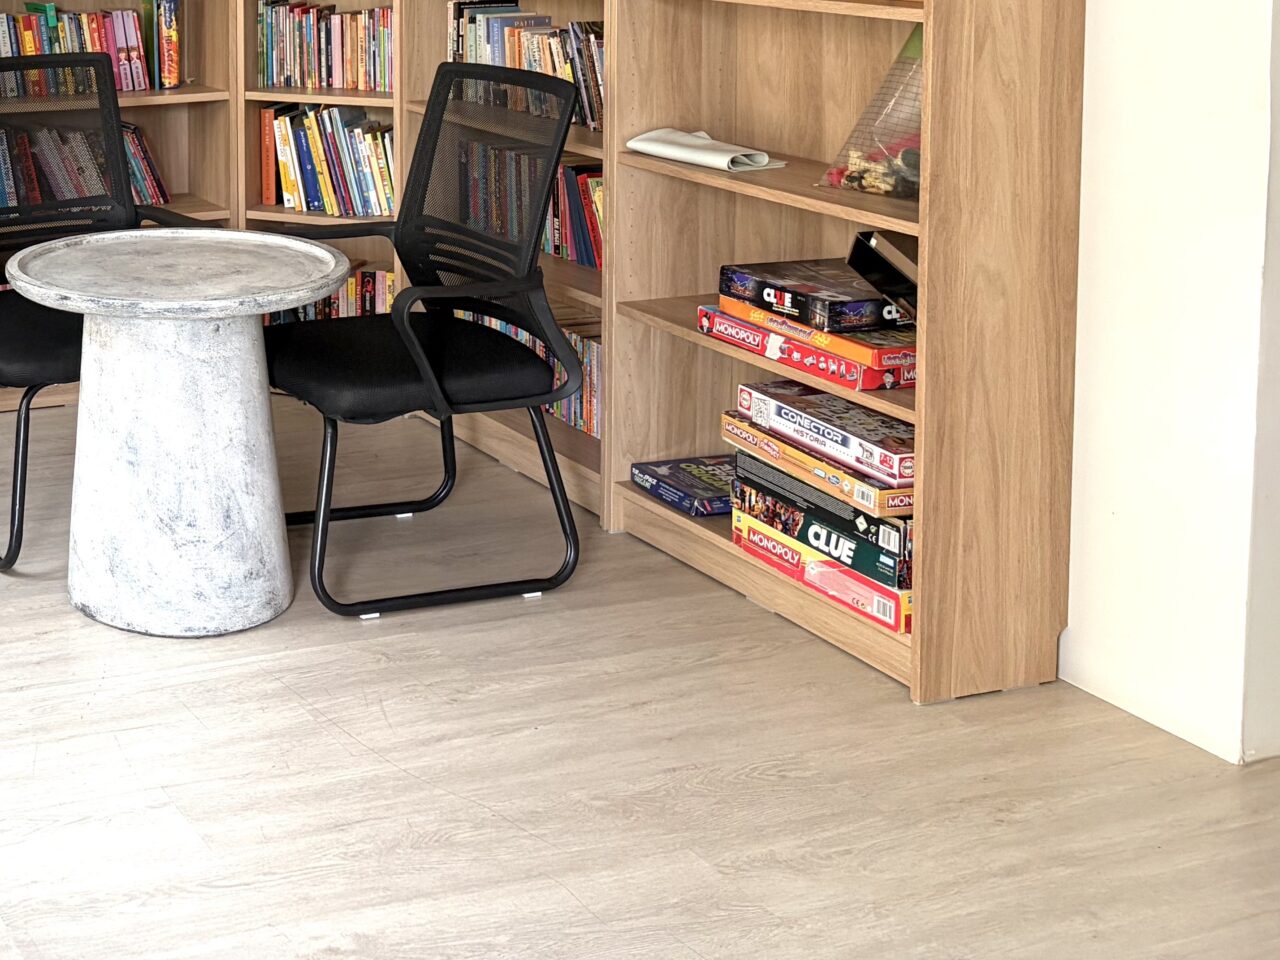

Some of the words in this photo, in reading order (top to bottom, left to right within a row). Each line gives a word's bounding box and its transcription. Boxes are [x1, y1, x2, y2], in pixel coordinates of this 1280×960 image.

[763, 287, 792, 307] CLUE
[715, 321, 760, 344] MONOPOLY
[725, 423, 758, 443] MONOPOLY
[781, 409, 844, 443] CONECTOR
[793, 427, 826, 446] HISTORIA
[750, 532, 799, 563] MONOPOLY
[808, 525, 856, 564] CLUE
